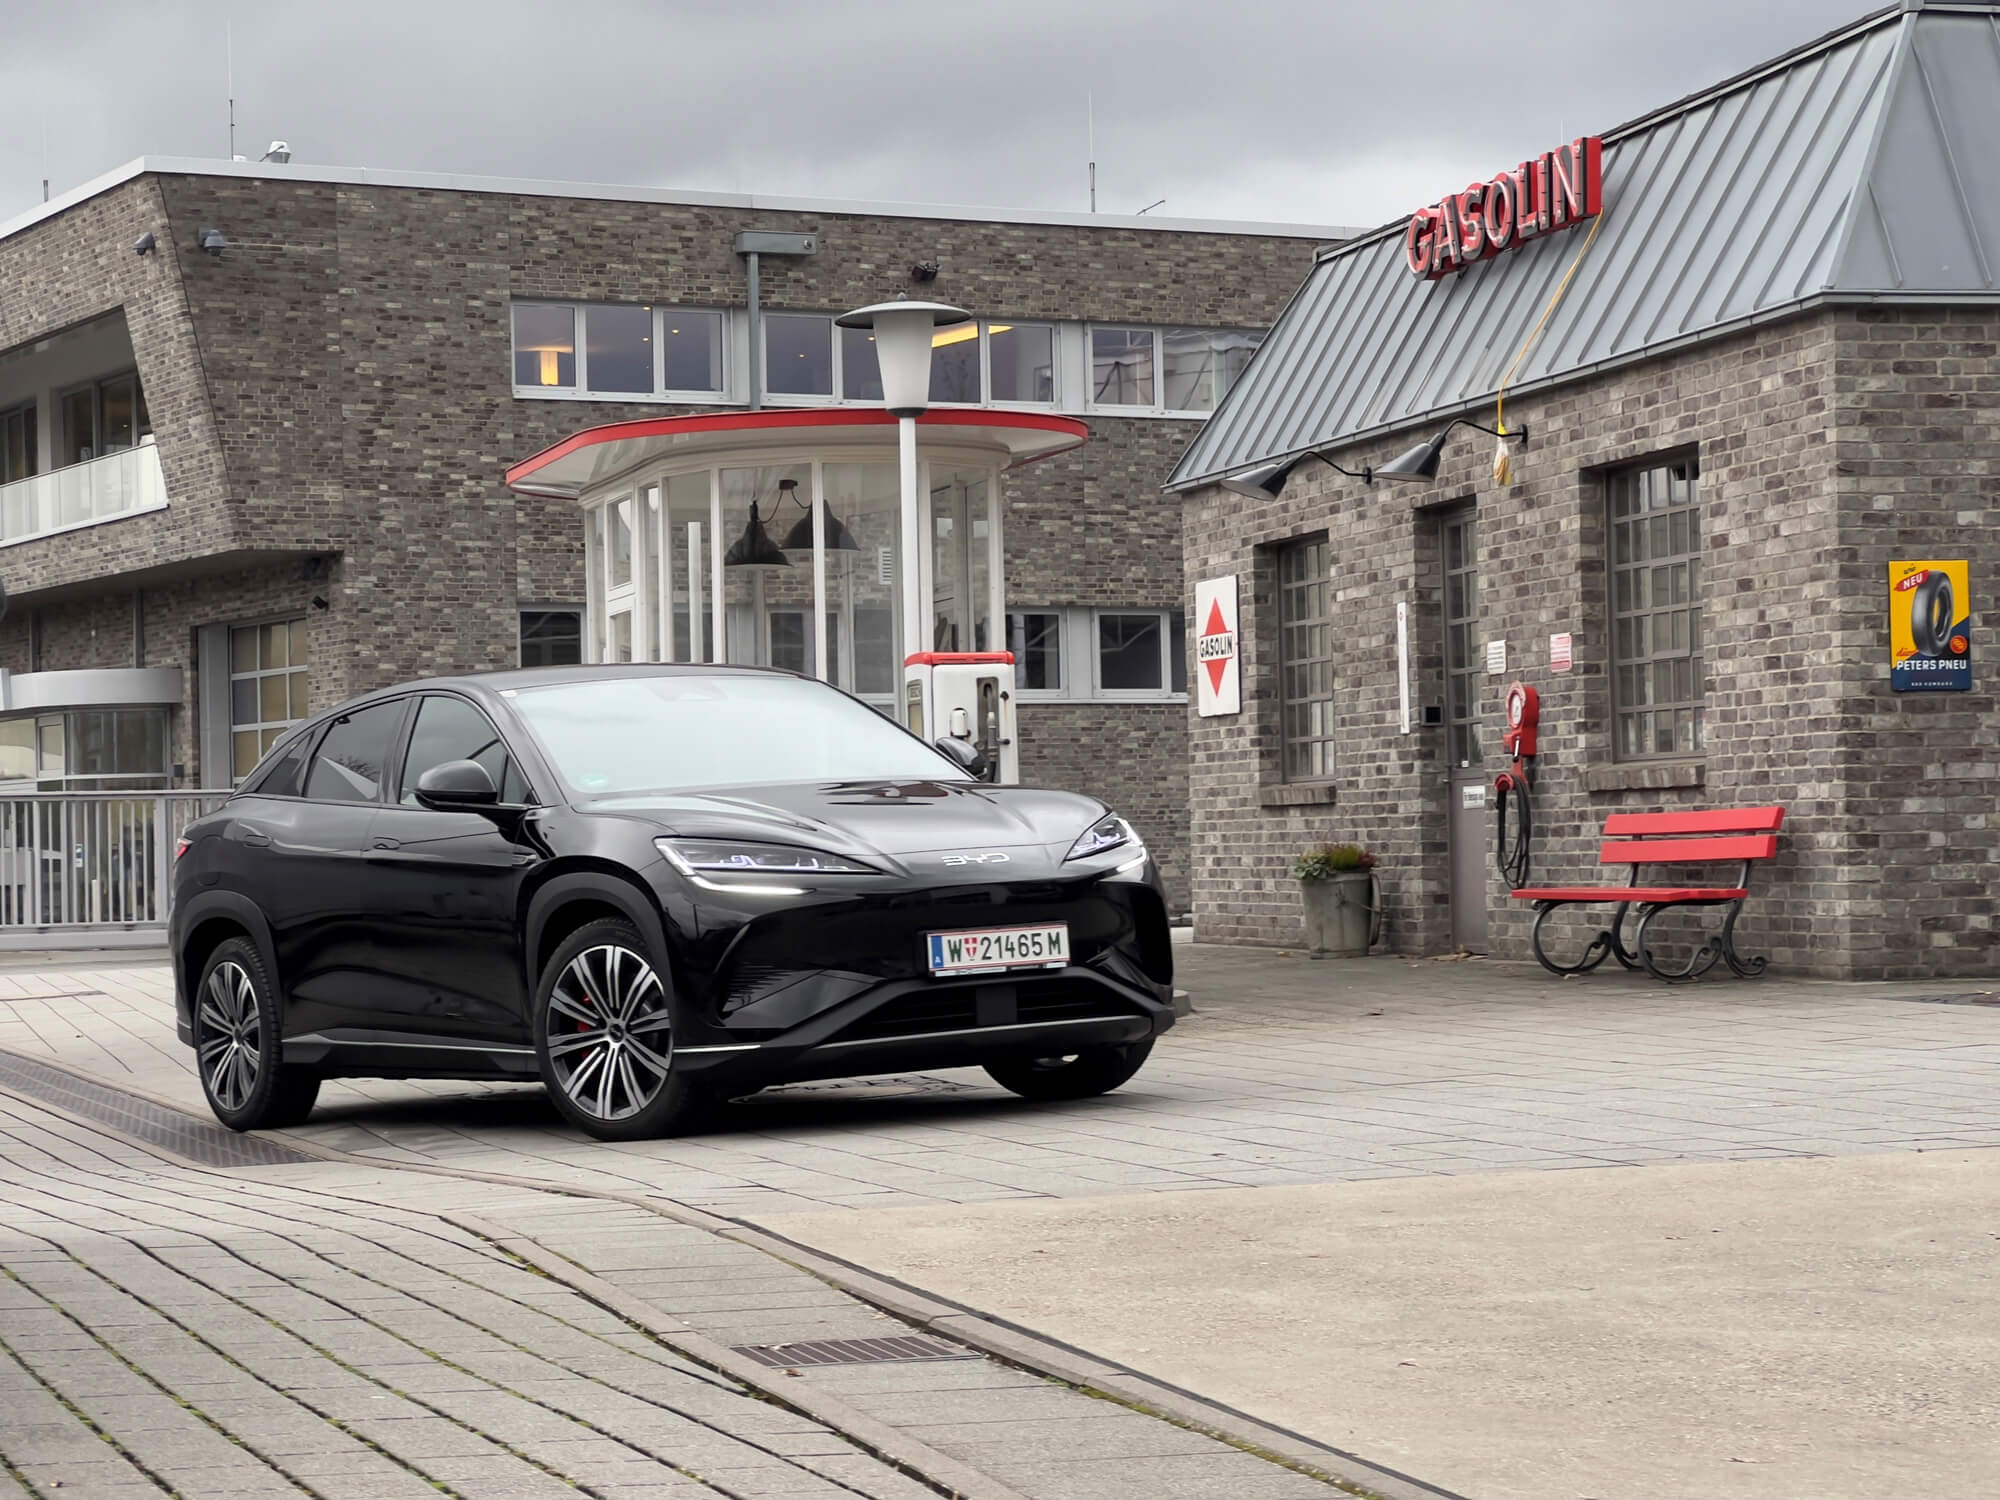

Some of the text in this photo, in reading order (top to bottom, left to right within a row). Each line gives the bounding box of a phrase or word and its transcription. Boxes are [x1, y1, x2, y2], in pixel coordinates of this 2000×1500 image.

[1407, 137, 1601, 281] GASOLIN
[1903, 571, 1923, 590] NEU
[1200, 636, 1232, 658] GASOLIN
[1896, 659, 1967, 671] PETERS PNEU
[941, 852, 1010, 866] BYD
[948, 931, 1062, 962] W 21465 M
